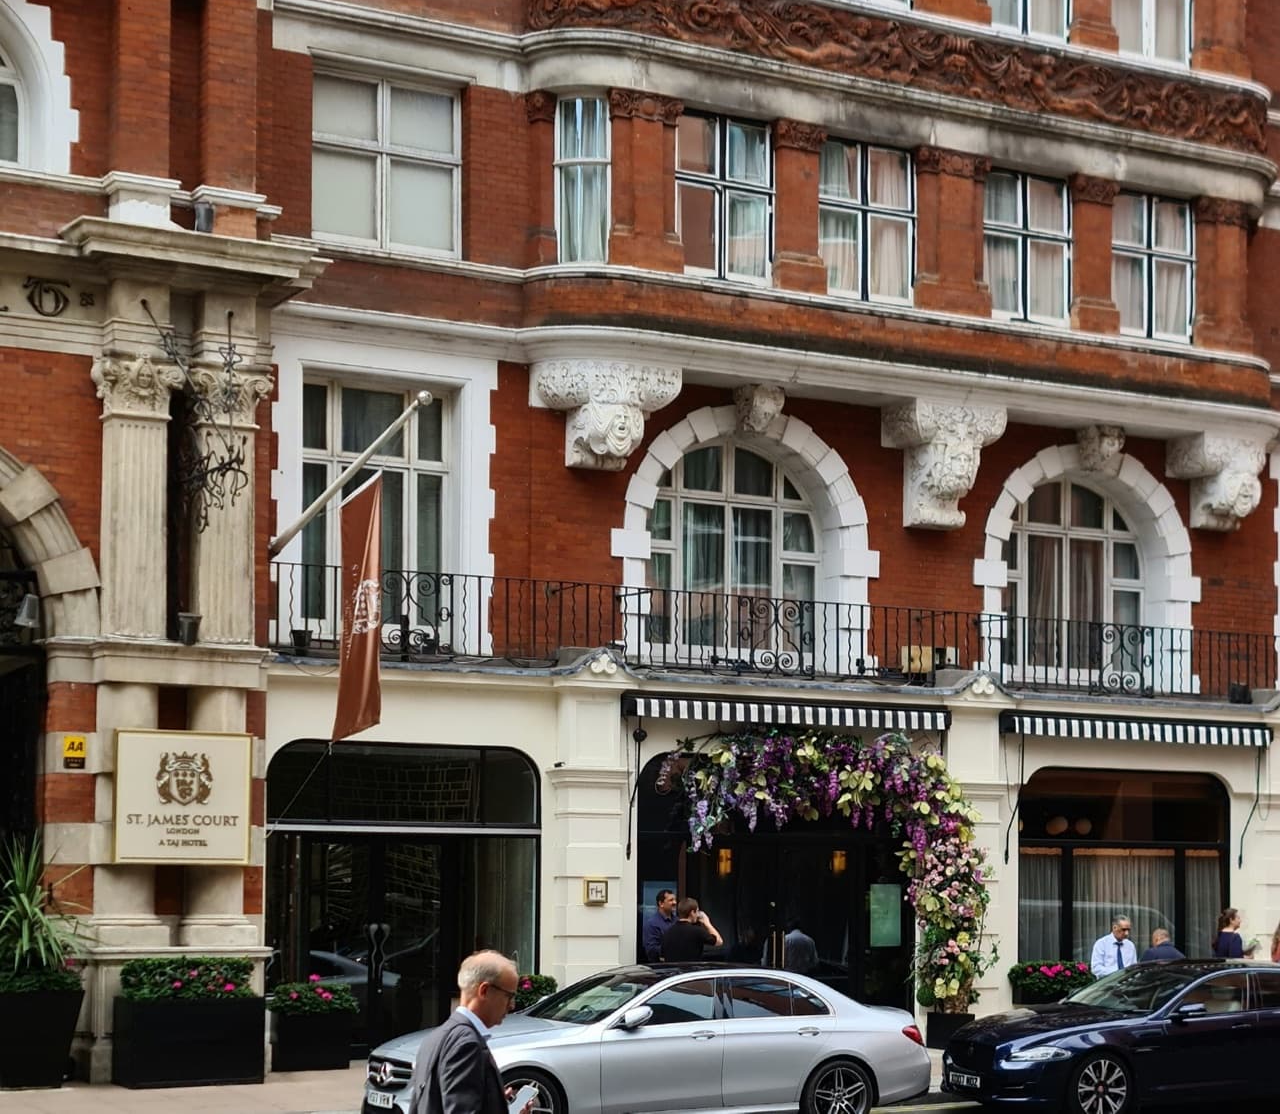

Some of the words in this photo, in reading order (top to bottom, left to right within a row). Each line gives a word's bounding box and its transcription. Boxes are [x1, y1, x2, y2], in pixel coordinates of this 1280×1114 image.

[66, 741, 84, 752] AA
[126, 813, 144, 825] ST.
[192, 814, 239, 827] COURT
[166, 827, 200, 835] LONDON
[158, 839, 165, 847] A
[166, 839, 180, 848] TAJ
[181, 839, 208, 848] HOTEL
